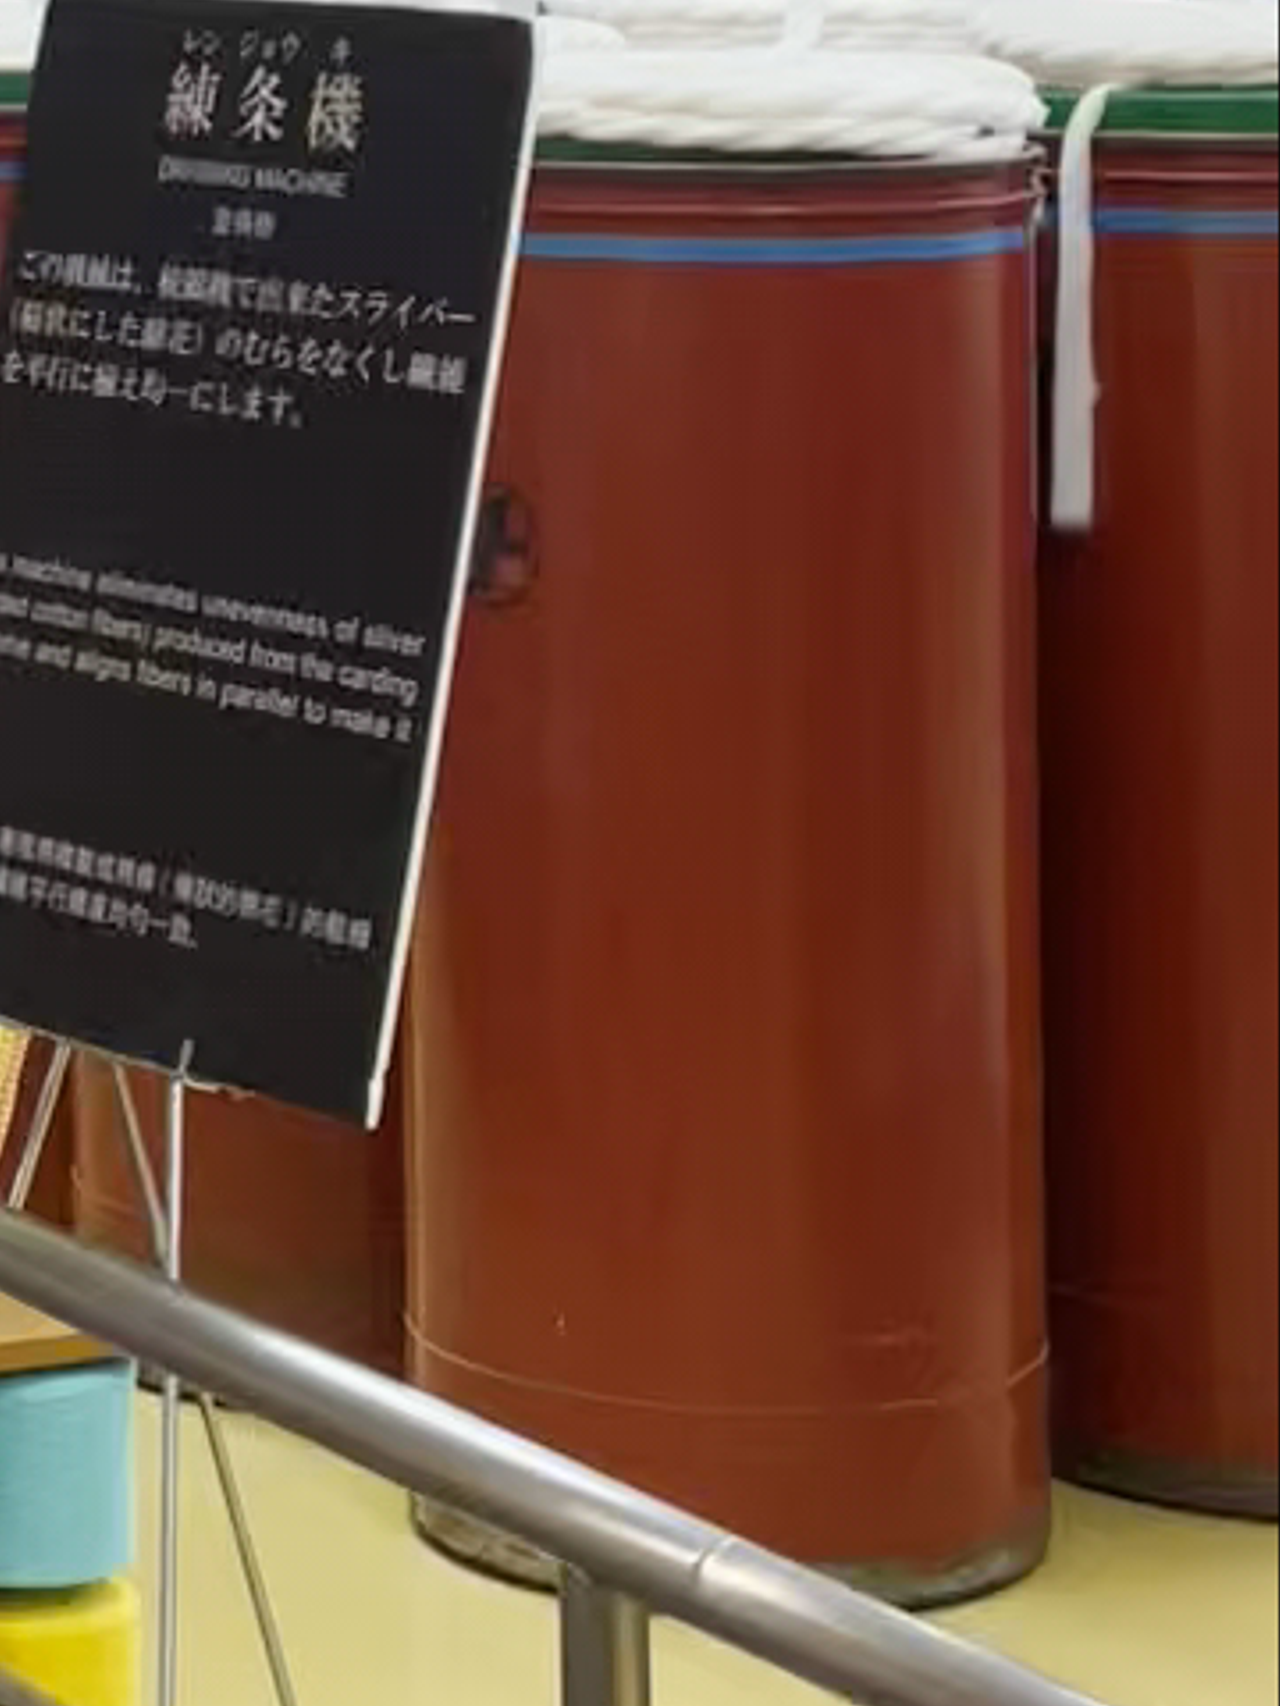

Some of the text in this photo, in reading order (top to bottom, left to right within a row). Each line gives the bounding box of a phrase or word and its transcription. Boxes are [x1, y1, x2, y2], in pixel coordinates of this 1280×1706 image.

[163, 60, 365, 153] 練条機
[333, 616, 360, 644] of
[153, 626, 247, 666] produced
[249, 640, 297, 675] from
[300, 650, 333, 682] the
[338, 665, 420, 708] carding
[196, 675, 216, 702] in
[218, 682, 300, 718] parallel
[303, 697, 328, 725] to
